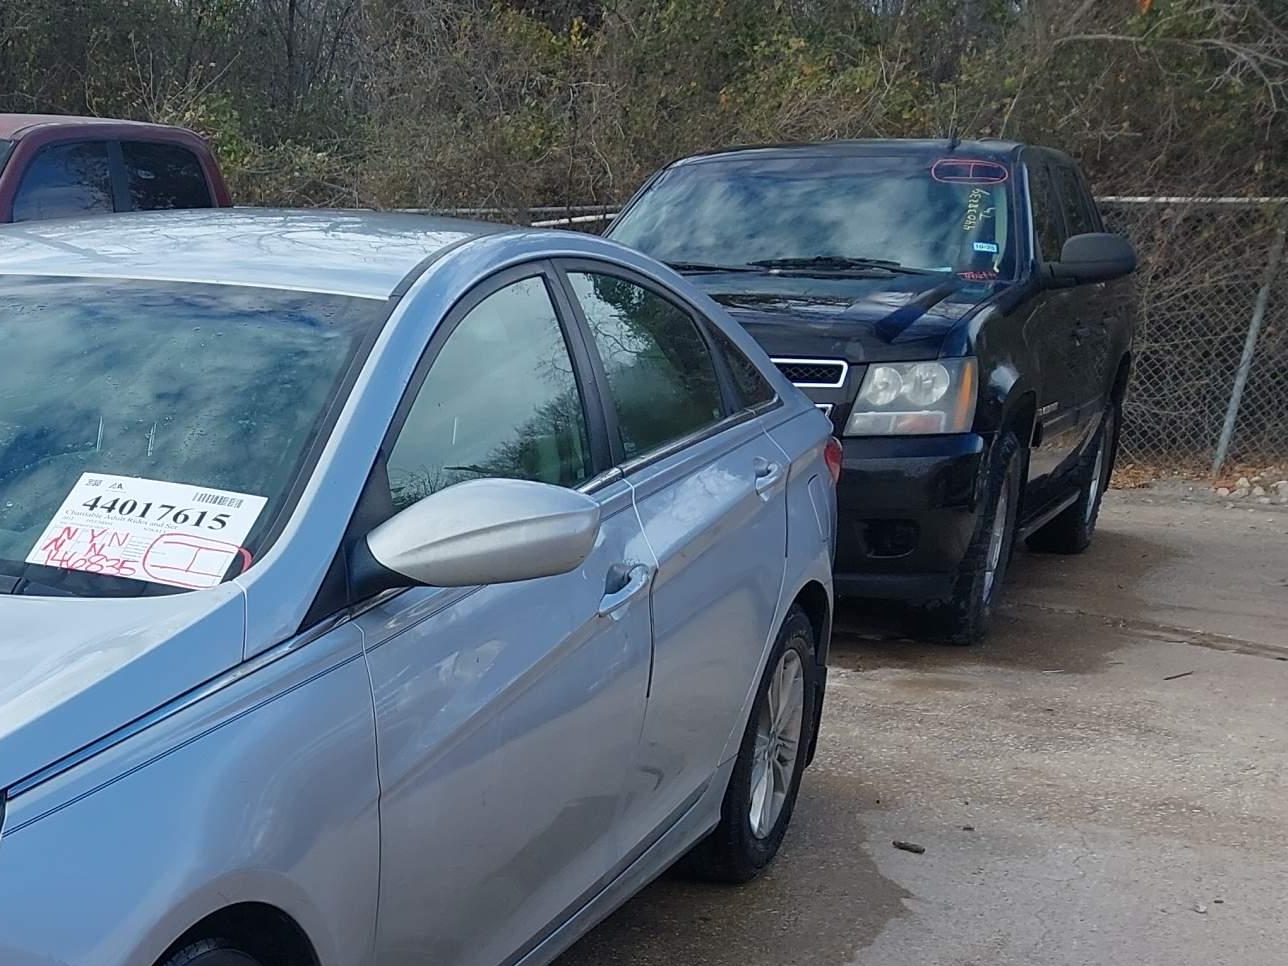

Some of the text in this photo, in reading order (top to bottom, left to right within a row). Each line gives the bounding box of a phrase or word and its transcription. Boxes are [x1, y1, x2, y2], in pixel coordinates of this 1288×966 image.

[65, 509, 103, 520] Charitable
[104, 514, 126, 522] Adult
[128, 517, 148, 526] Rides
[82, 496, 232, 530] 44017615
[89, 528, 108, 543] Y
[107, 531, 130, 547] N
[84, 543, 105, 556] N
